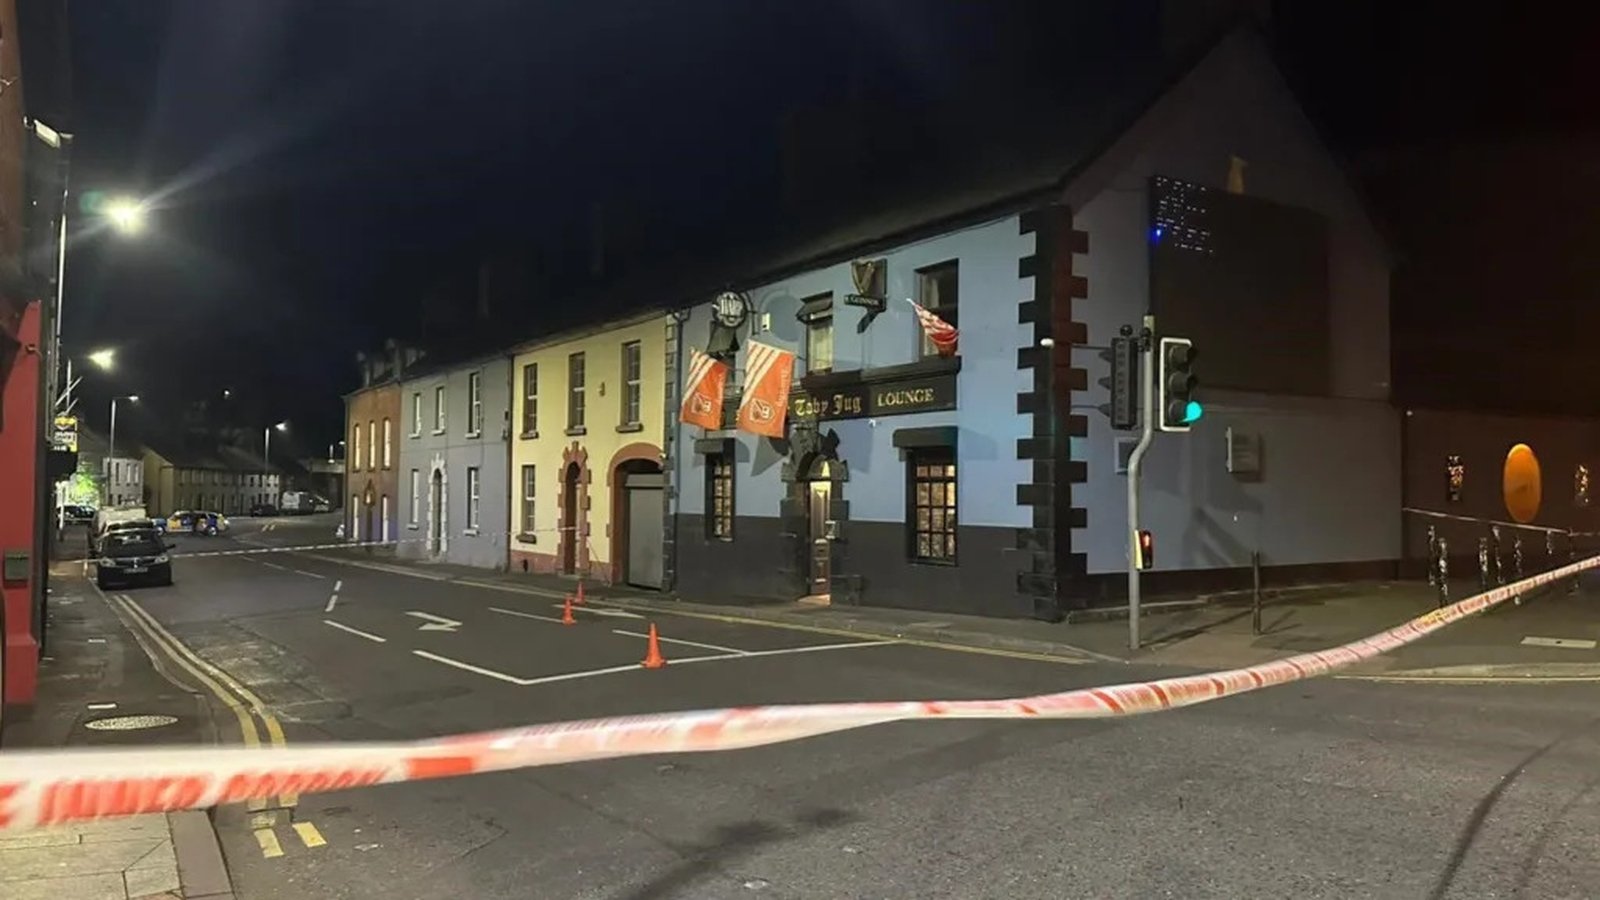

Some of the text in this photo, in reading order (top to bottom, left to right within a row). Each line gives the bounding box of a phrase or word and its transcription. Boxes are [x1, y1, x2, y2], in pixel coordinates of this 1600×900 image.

[795, 397, 828, 417] Toby
[832, 393, 862, 415] Jug
[877, 388, 934, 407] LOUNGE
